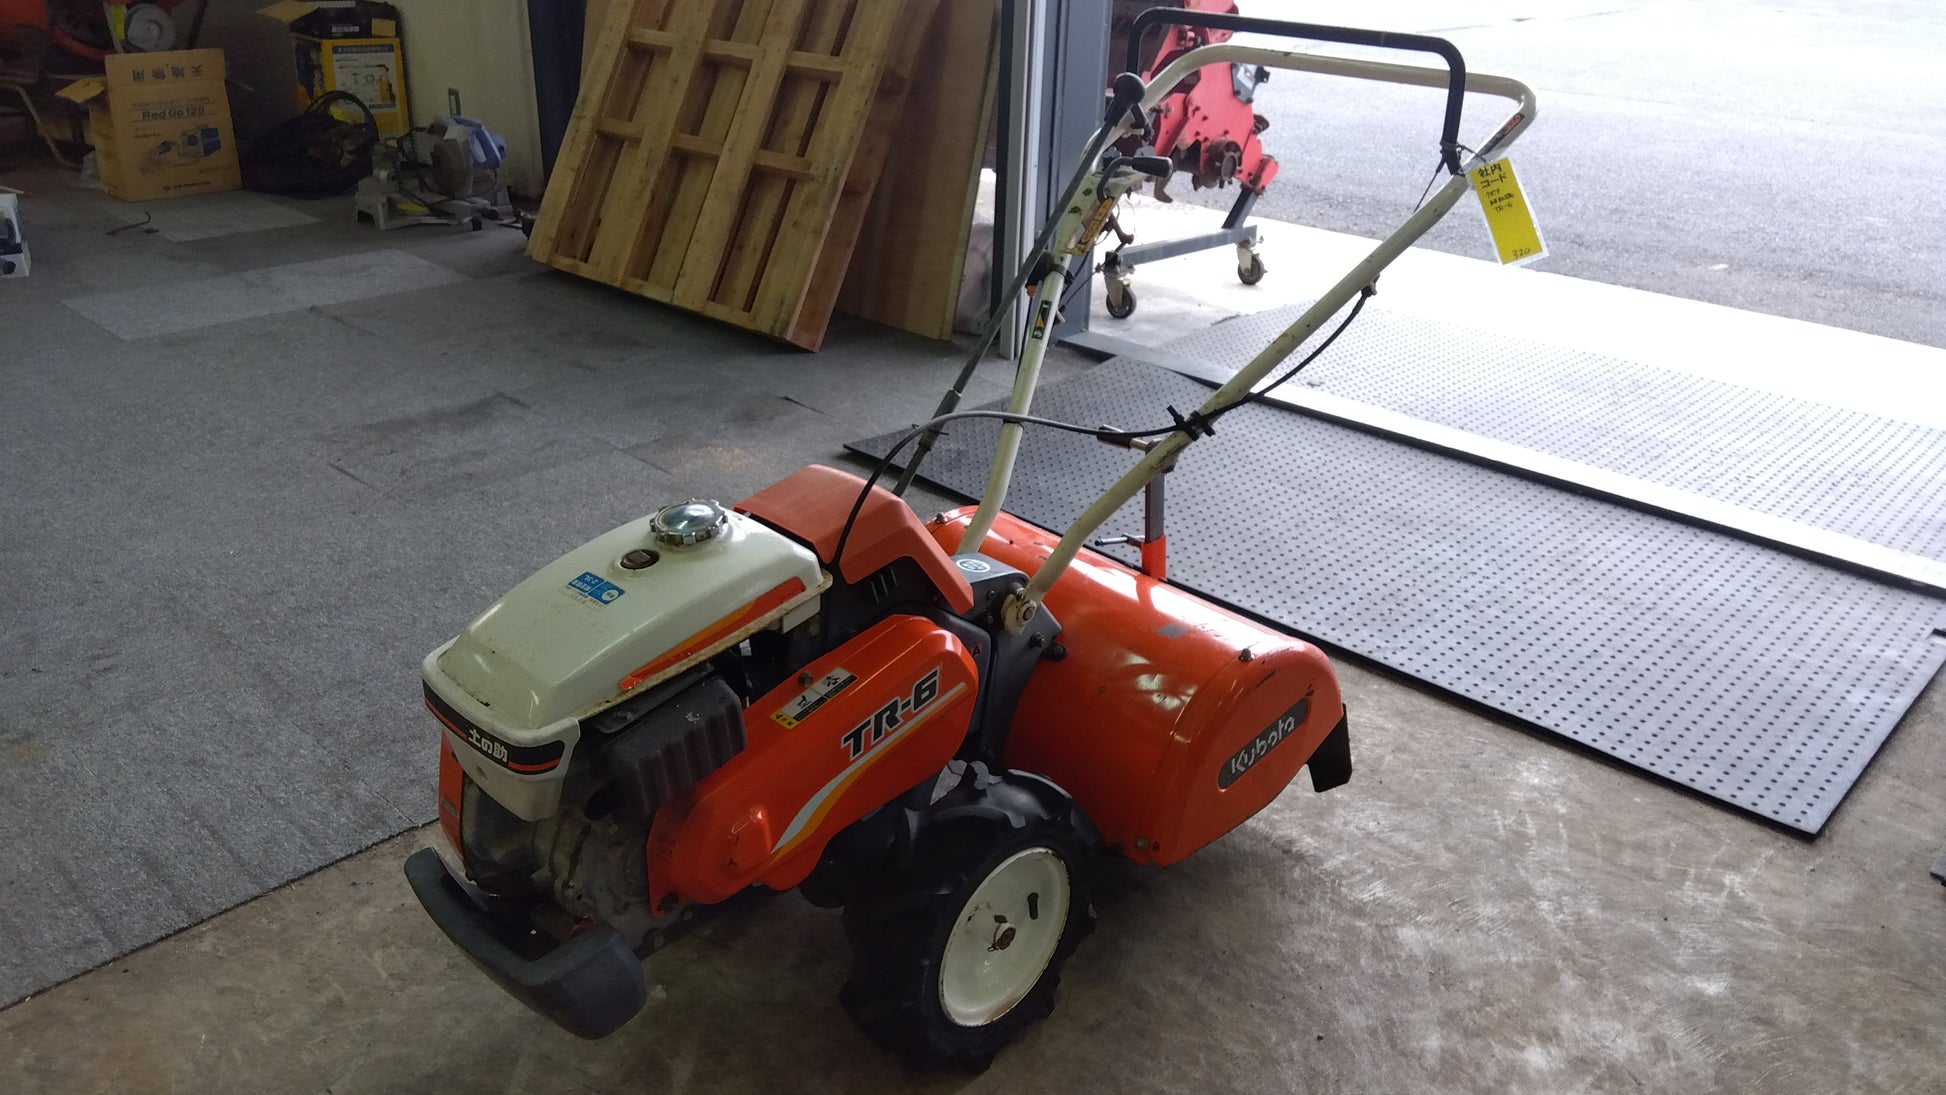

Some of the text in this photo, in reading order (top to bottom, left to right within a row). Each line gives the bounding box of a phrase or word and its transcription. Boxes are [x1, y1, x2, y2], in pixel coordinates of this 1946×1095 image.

[142, 109, 166, 120] Red
[186, 105, 205, 116] 120
[1478, 163, 1502, 178] 社内
[1480, 172, 1507, 189] コード
[842, 667, 939, 760] TR-6
[468, 728, 508, 763] 土の助
[1231, 716, 1295, 774] Kubota
